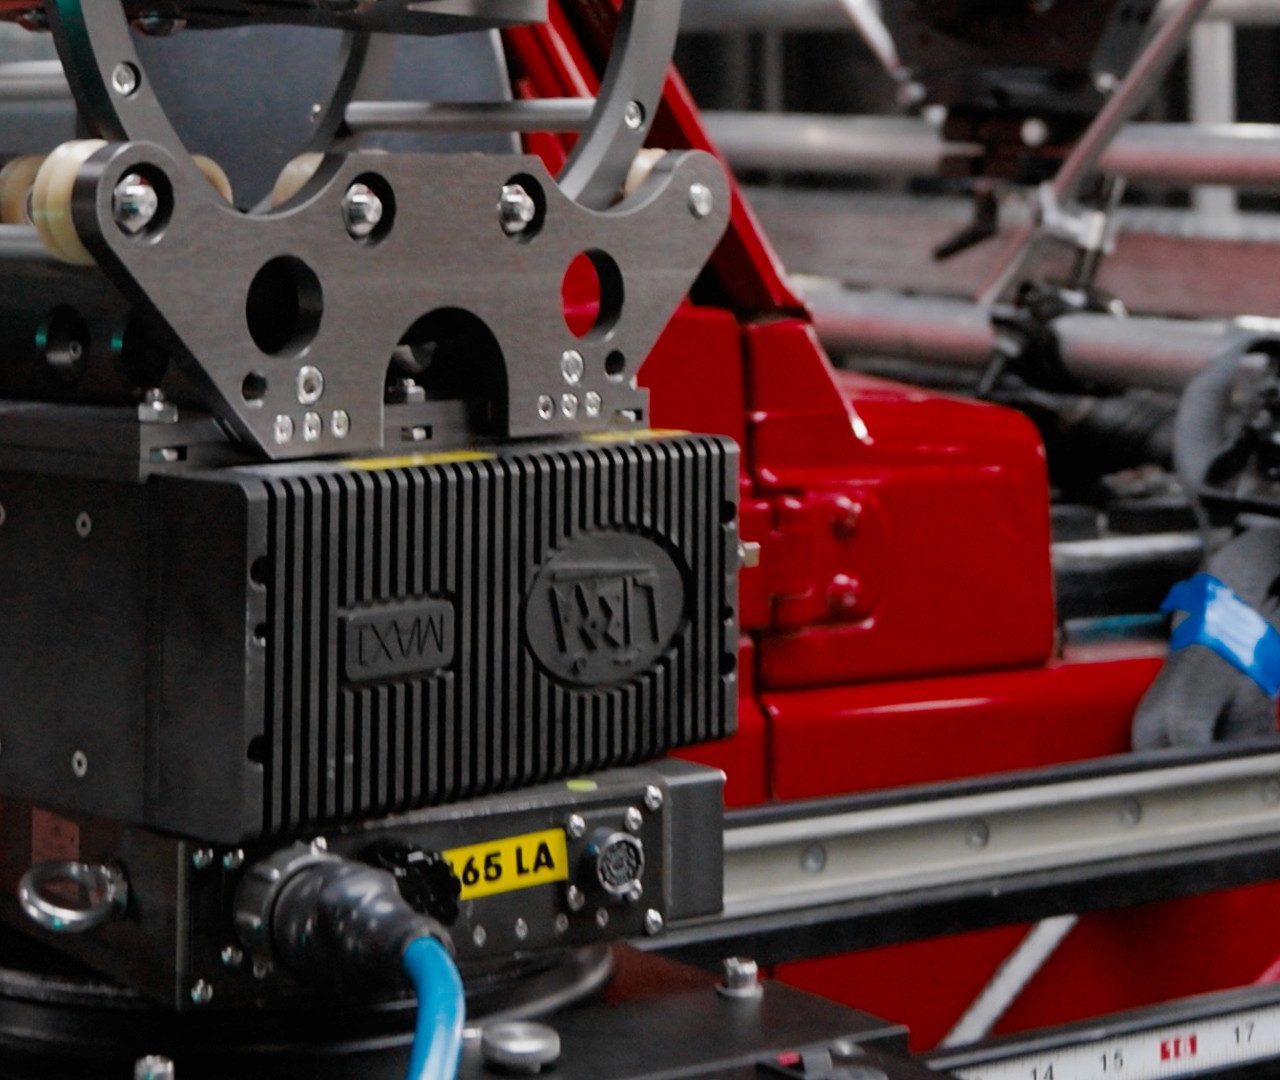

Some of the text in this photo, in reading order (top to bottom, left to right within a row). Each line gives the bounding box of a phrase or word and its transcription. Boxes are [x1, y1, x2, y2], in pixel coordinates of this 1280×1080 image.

[451, 841, 556, 887] 65 LA
[1032, 1063, 1054, 1080] 14
[1100, 1049, 1124, 1073] 15
[1234, 1022, 1255, 1044] 17
